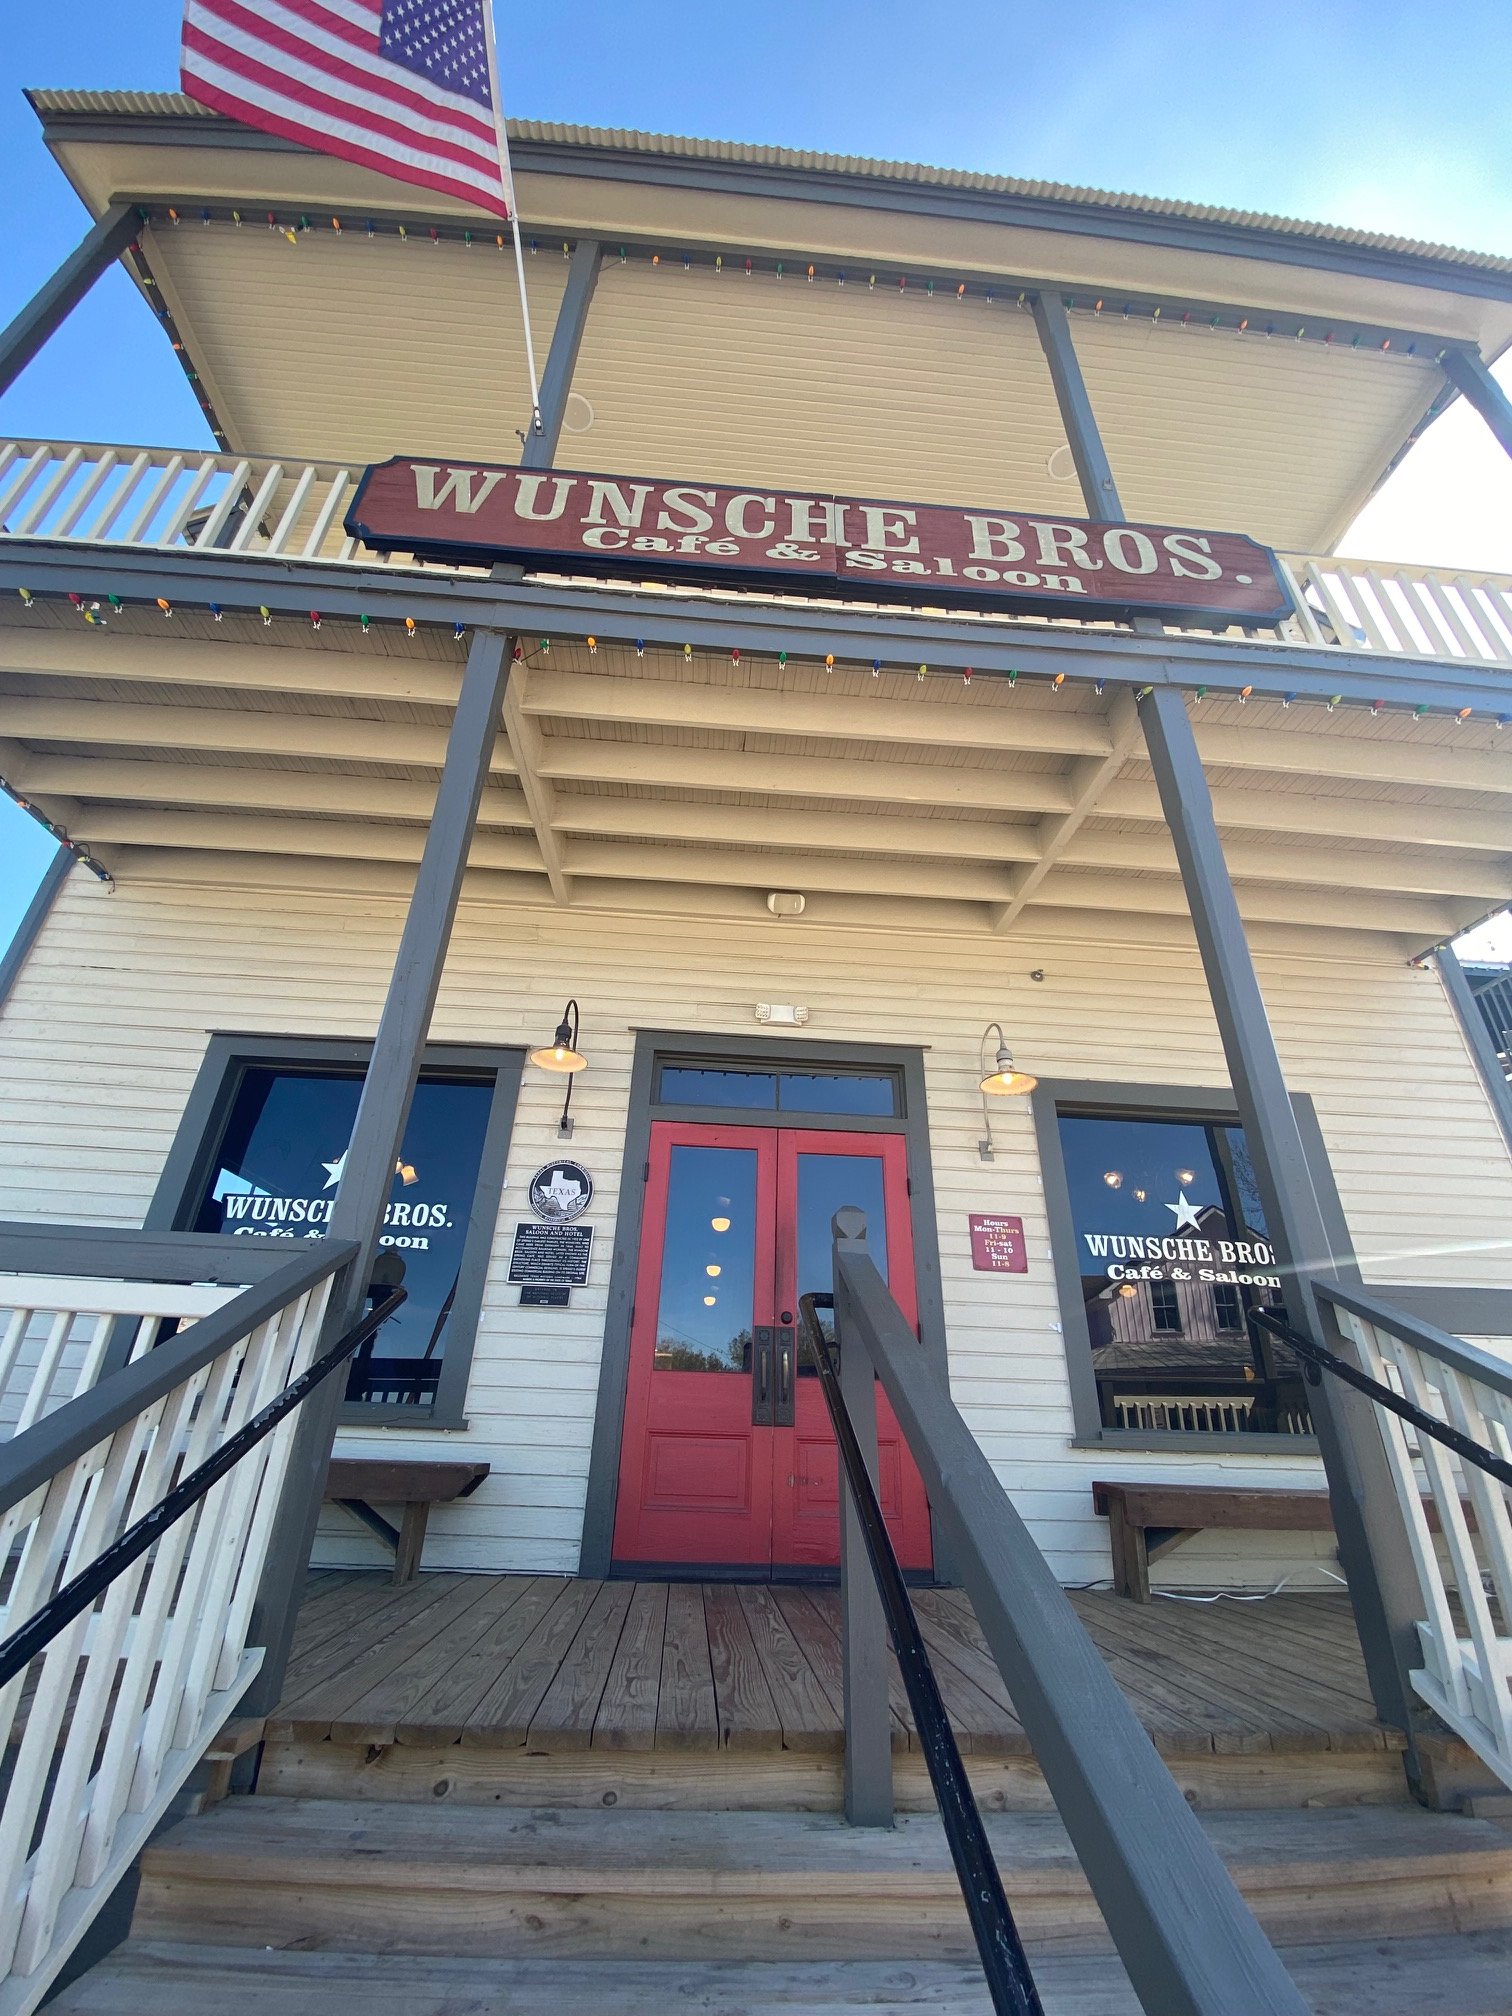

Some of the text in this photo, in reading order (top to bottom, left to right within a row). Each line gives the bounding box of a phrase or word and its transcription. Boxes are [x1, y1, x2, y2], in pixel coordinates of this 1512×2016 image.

[409, 465, 1253, 585] WUNSCHE BROS.
[582, 526, 1089, 594] Café & Saloon
[547, 1187, 576, 1196] TEXAS
[226, 1195, 334, 1223] WUNSC
[974, 1226, 1019, 1234] Mon-Thurs
[984, 1239, 1013, 1247] Fri-sat
[1084, 1234, 1213, 1262] WUNSCHE
[1107, 1263, 1282, 1289] Café & Saloon
